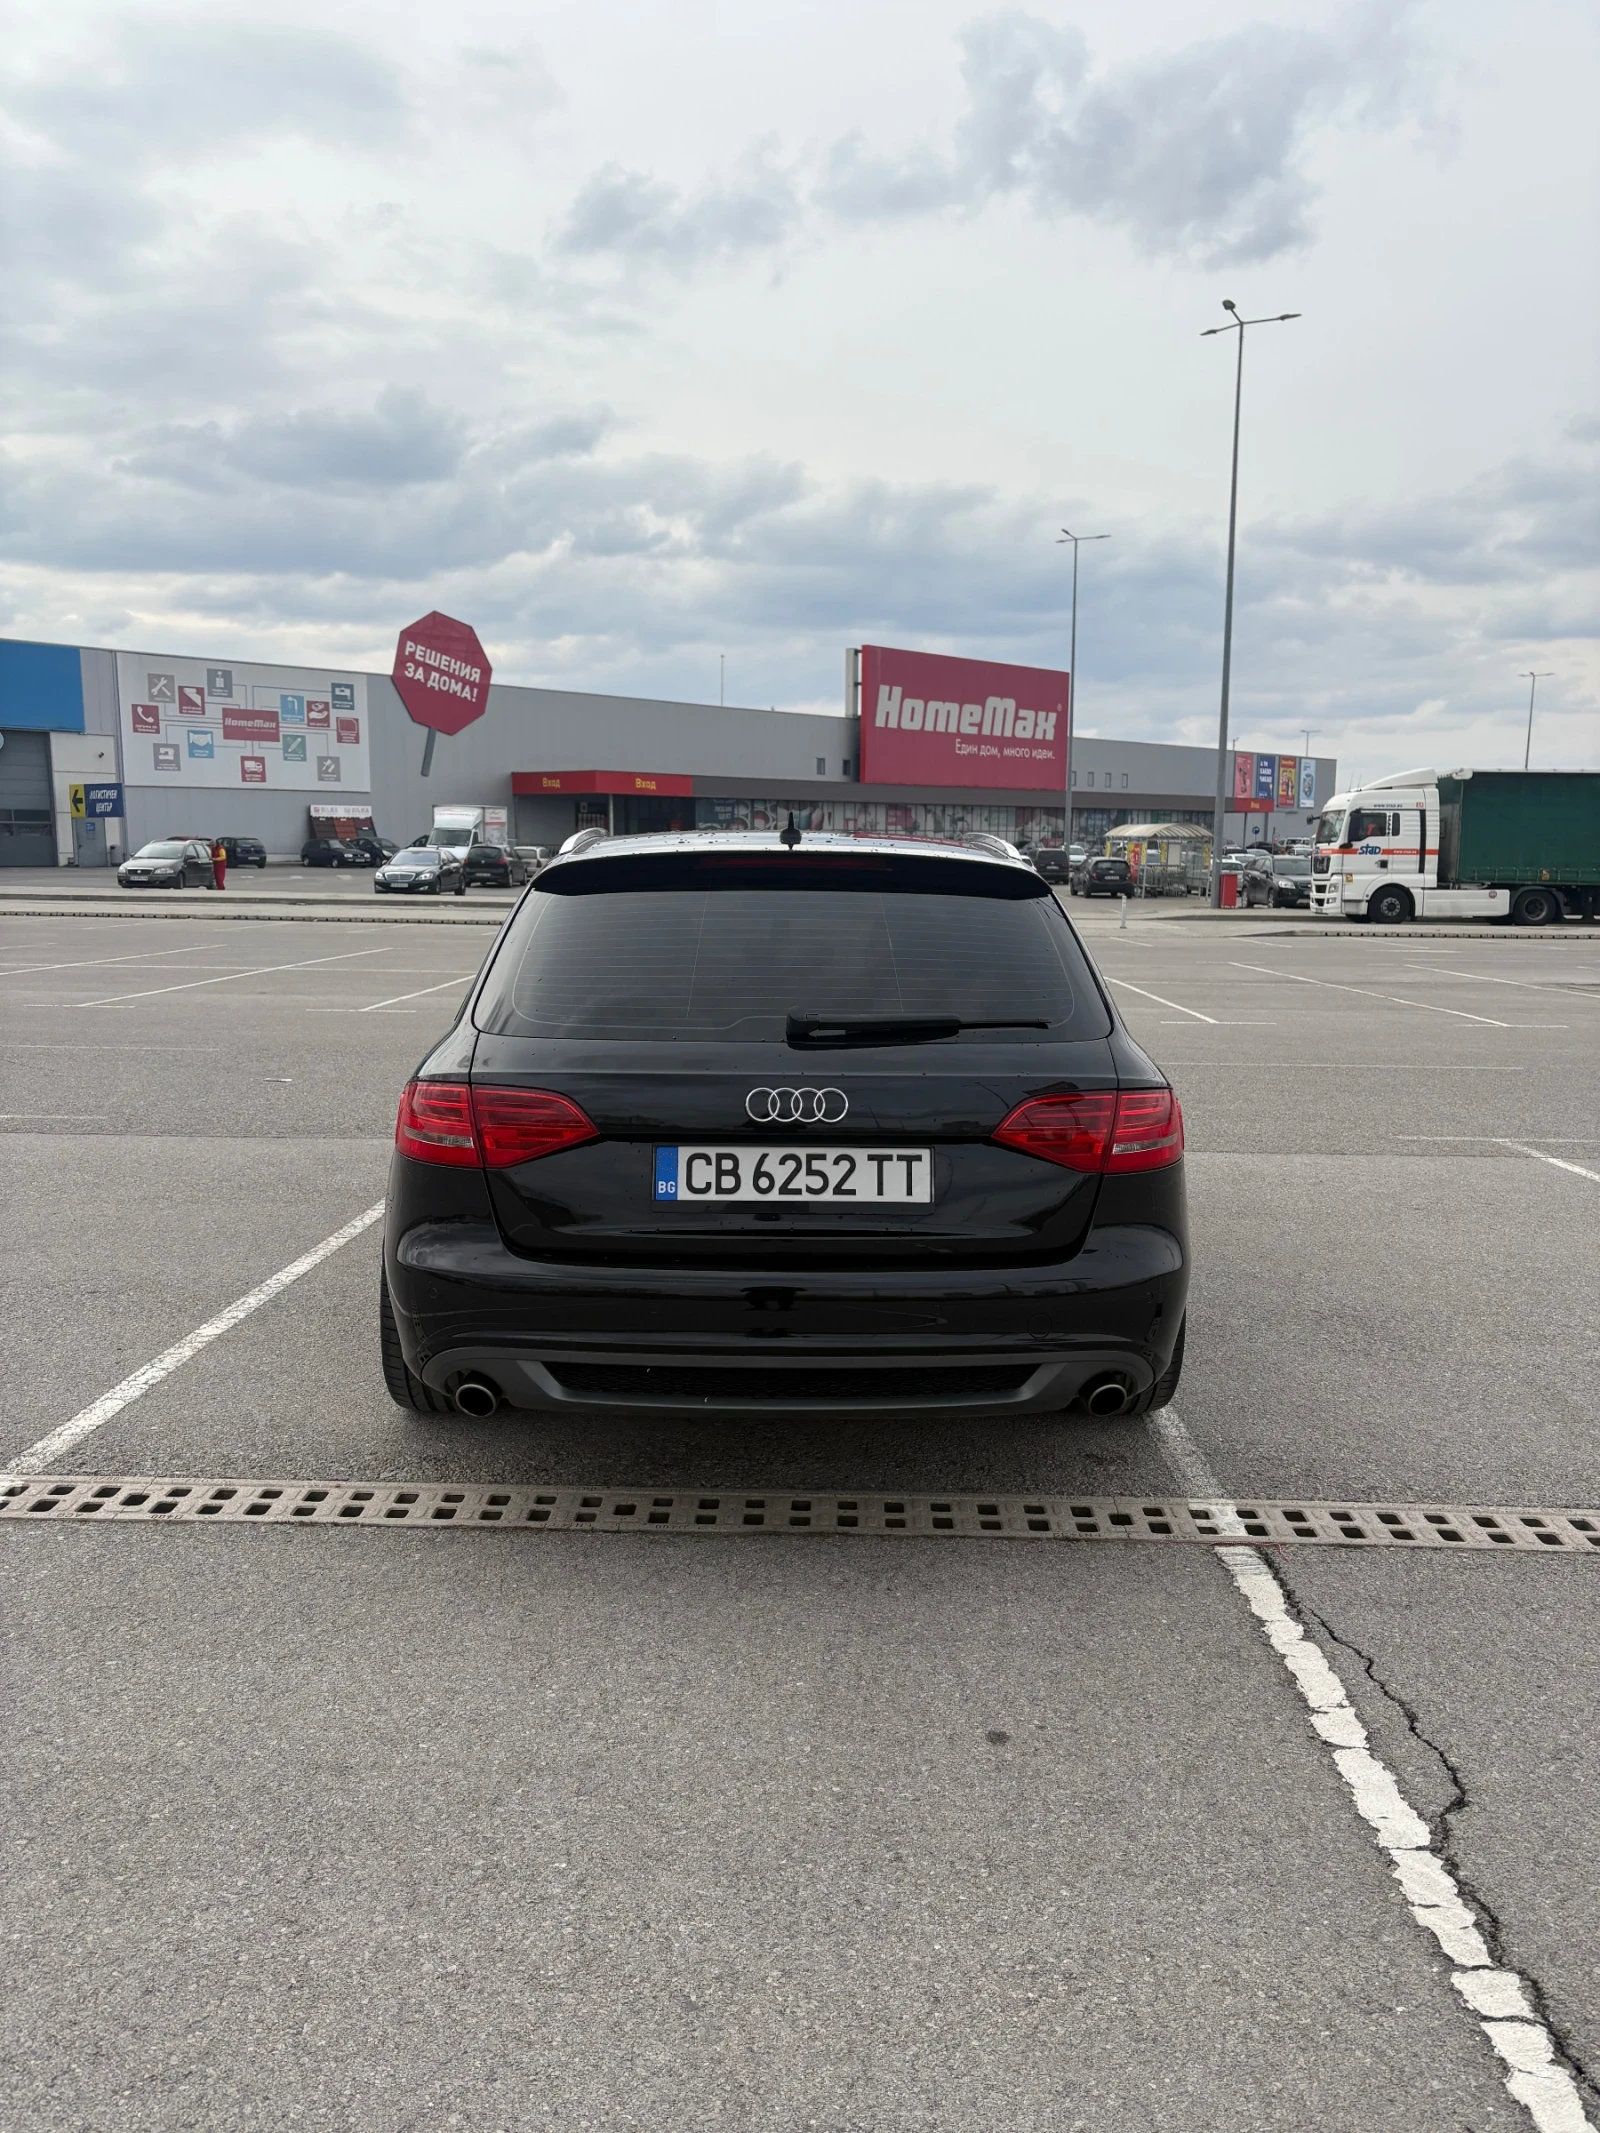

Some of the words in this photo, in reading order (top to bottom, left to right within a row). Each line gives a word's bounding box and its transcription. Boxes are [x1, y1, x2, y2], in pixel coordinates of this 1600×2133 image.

[405, 641, 481, 683] РЕШЕНИЯ
[404, 663, 425, 684] ЗА
[427, 673, 478, 702] ДОМА!
[875, 684, 1057, 741] HomeMax
[955, 739, 978, 755] Един
[979, 745, 1000, 758] дом,
[1003, 746, 1030, 759] много
[542, 777, 561, 789] Вход
[635, 778, 656, 790] Вход
[89, 789, 118, 800] ЛОГИСТИЧЕН
[686, 1152, 741, 1195] CB
[752, 1153, 857, 1196] 6252
[867, 1154, 922, 1197] TT
[658, 1181, 676, 1194] BG
